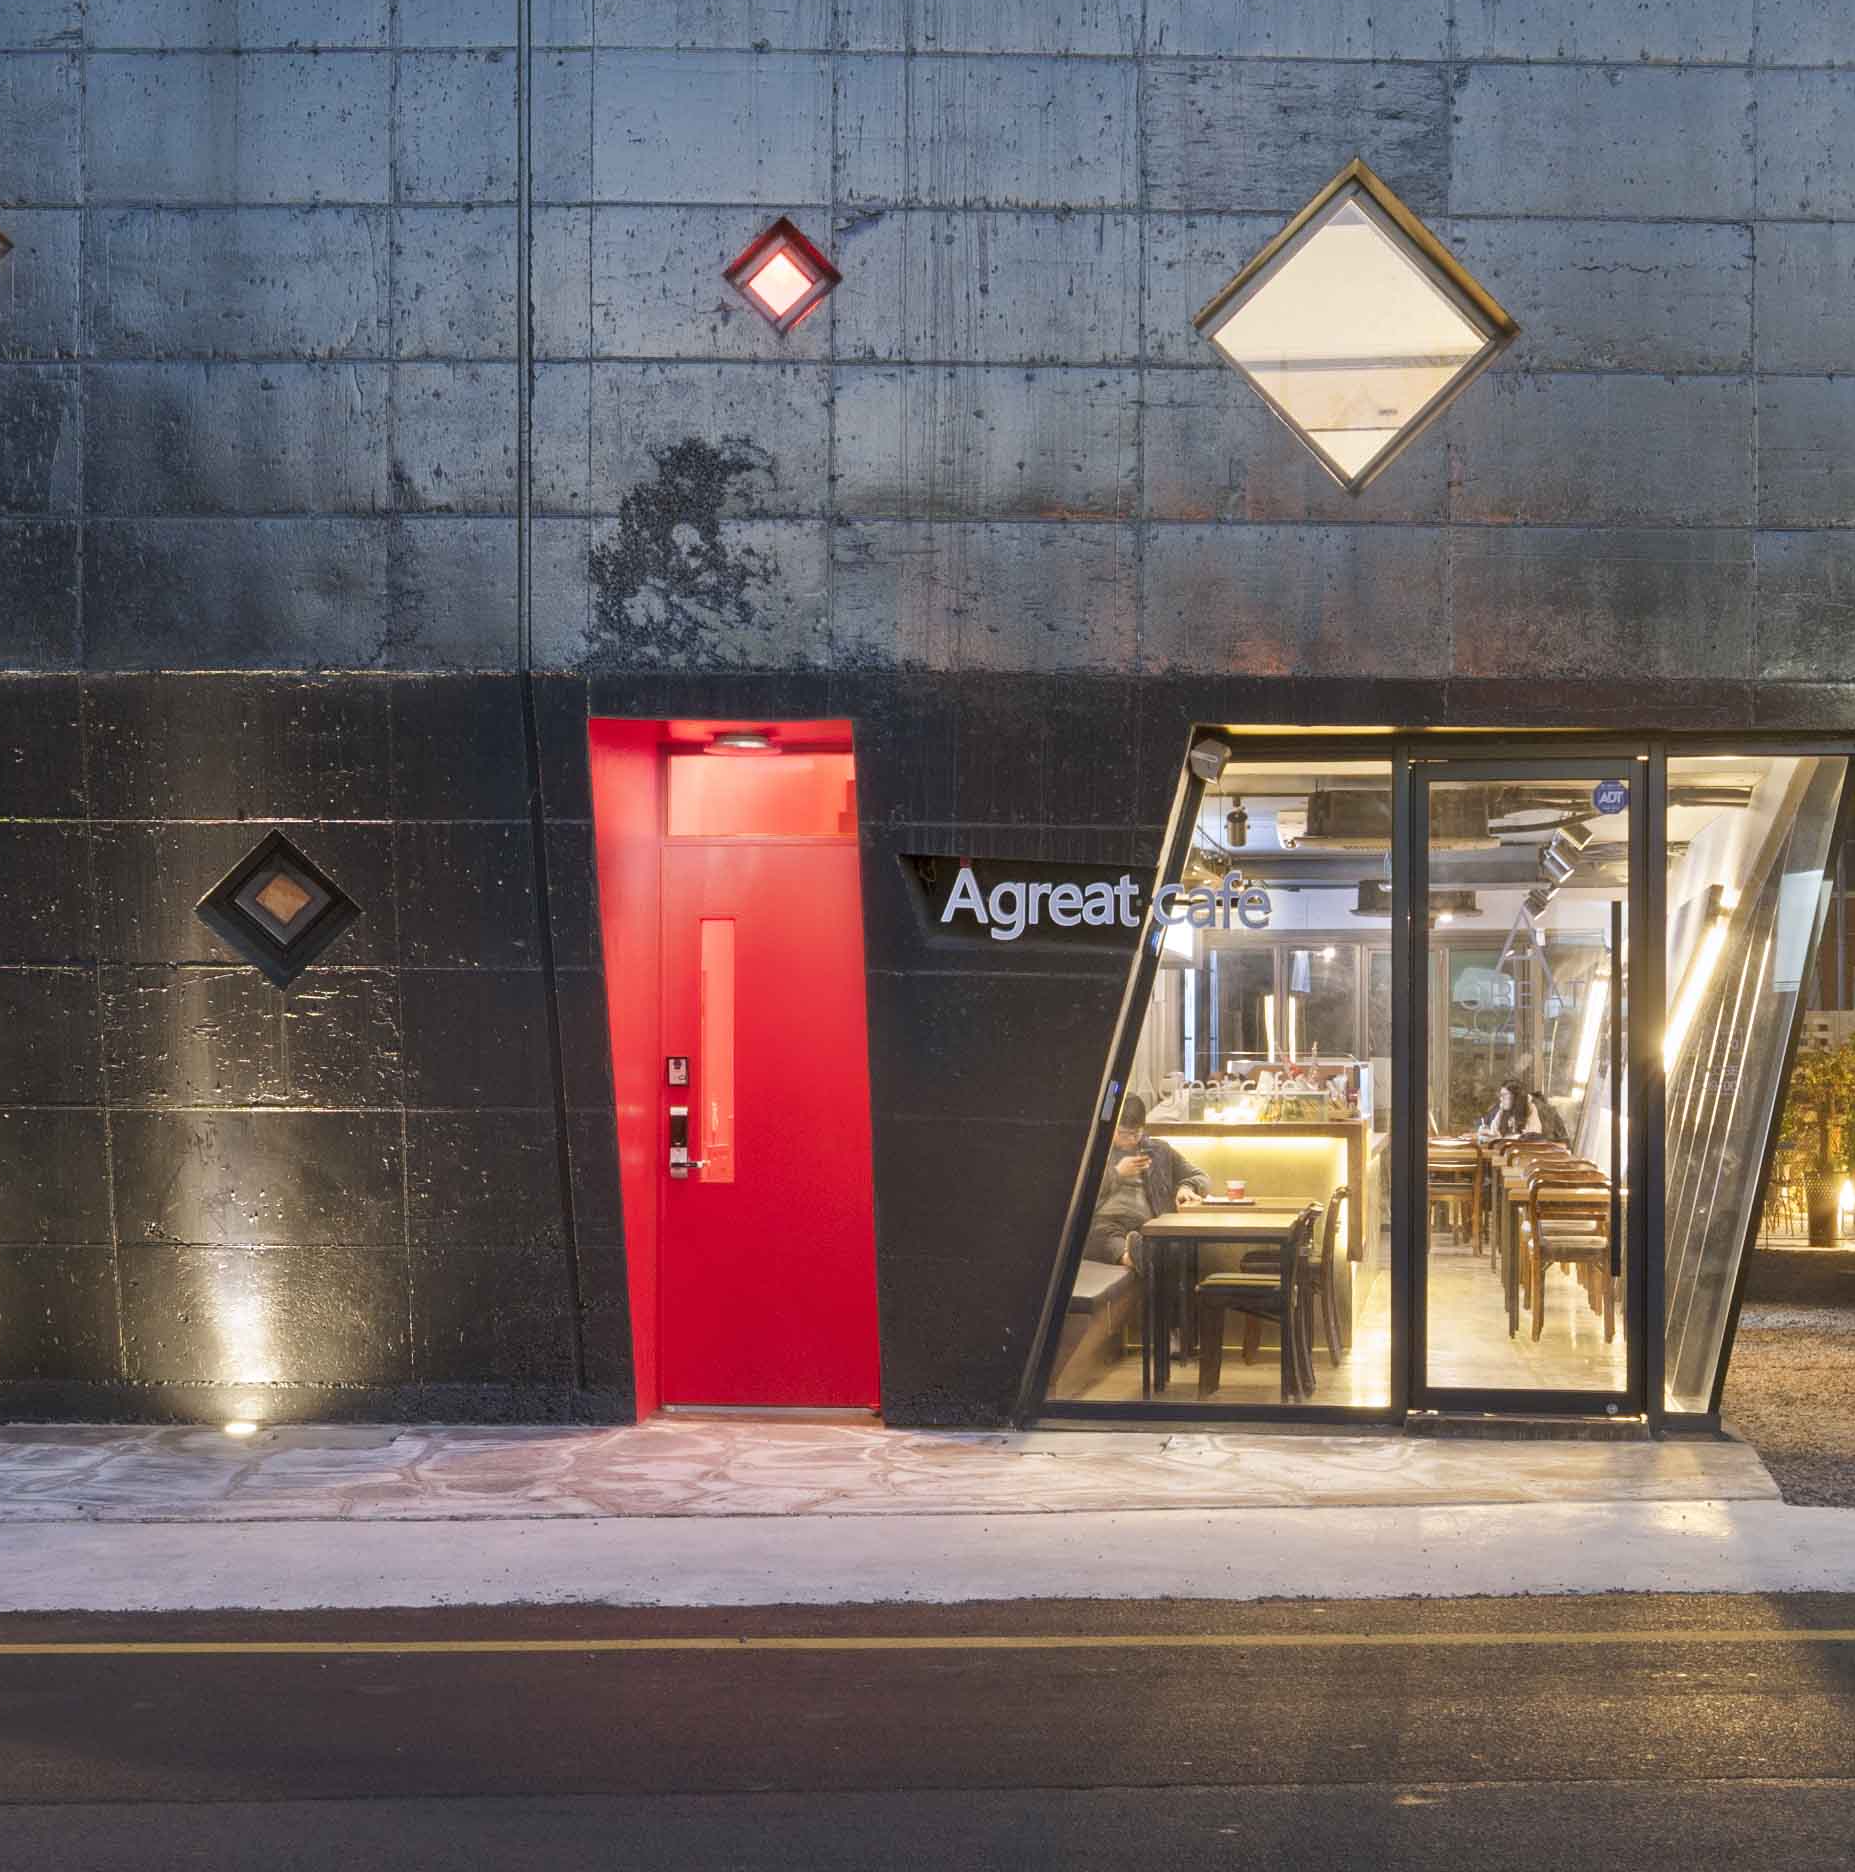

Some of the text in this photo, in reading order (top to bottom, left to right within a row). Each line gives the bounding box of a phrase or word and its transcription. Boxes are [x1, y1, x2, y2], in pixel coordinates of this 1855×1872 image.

[1600, 790, 1624, 804] ADT
[941, 866, 1273, 940] Agreat cafe
